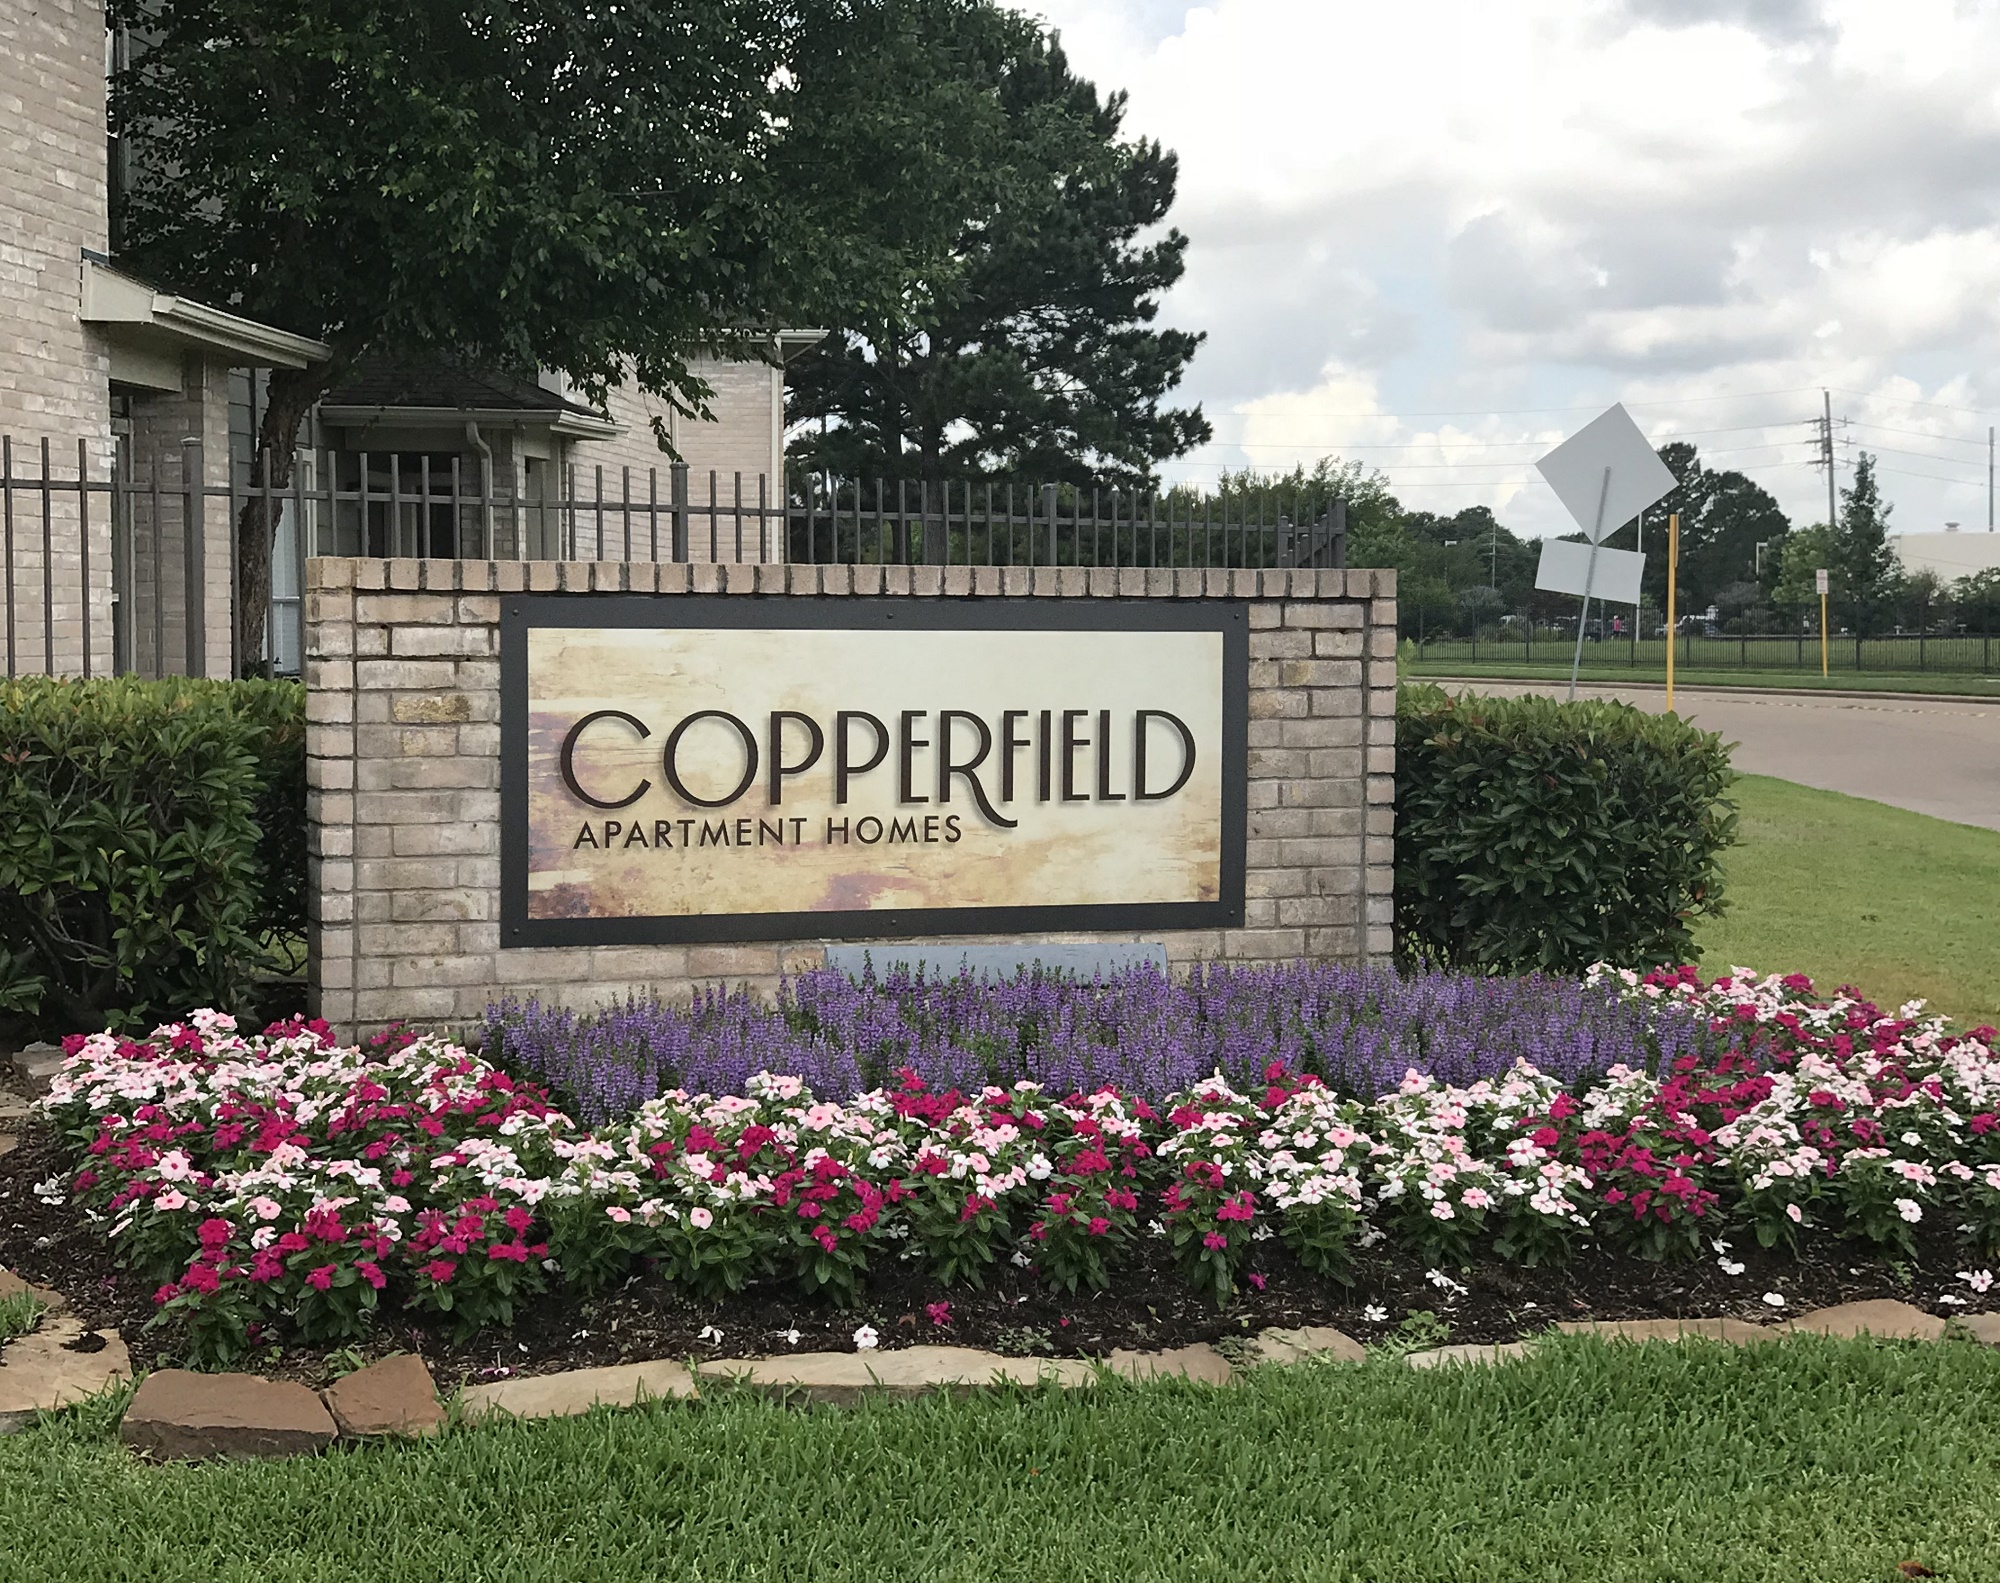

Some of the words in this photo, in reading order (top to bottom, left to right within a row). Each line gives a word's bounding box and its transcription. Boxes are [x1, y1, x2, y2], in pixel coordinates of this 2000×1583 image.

[560, 710, 1195, 828] COPPERFIELD
[573, 816, 807, 849] APARTMENT
[828, 815, 962, 845] HOMES
